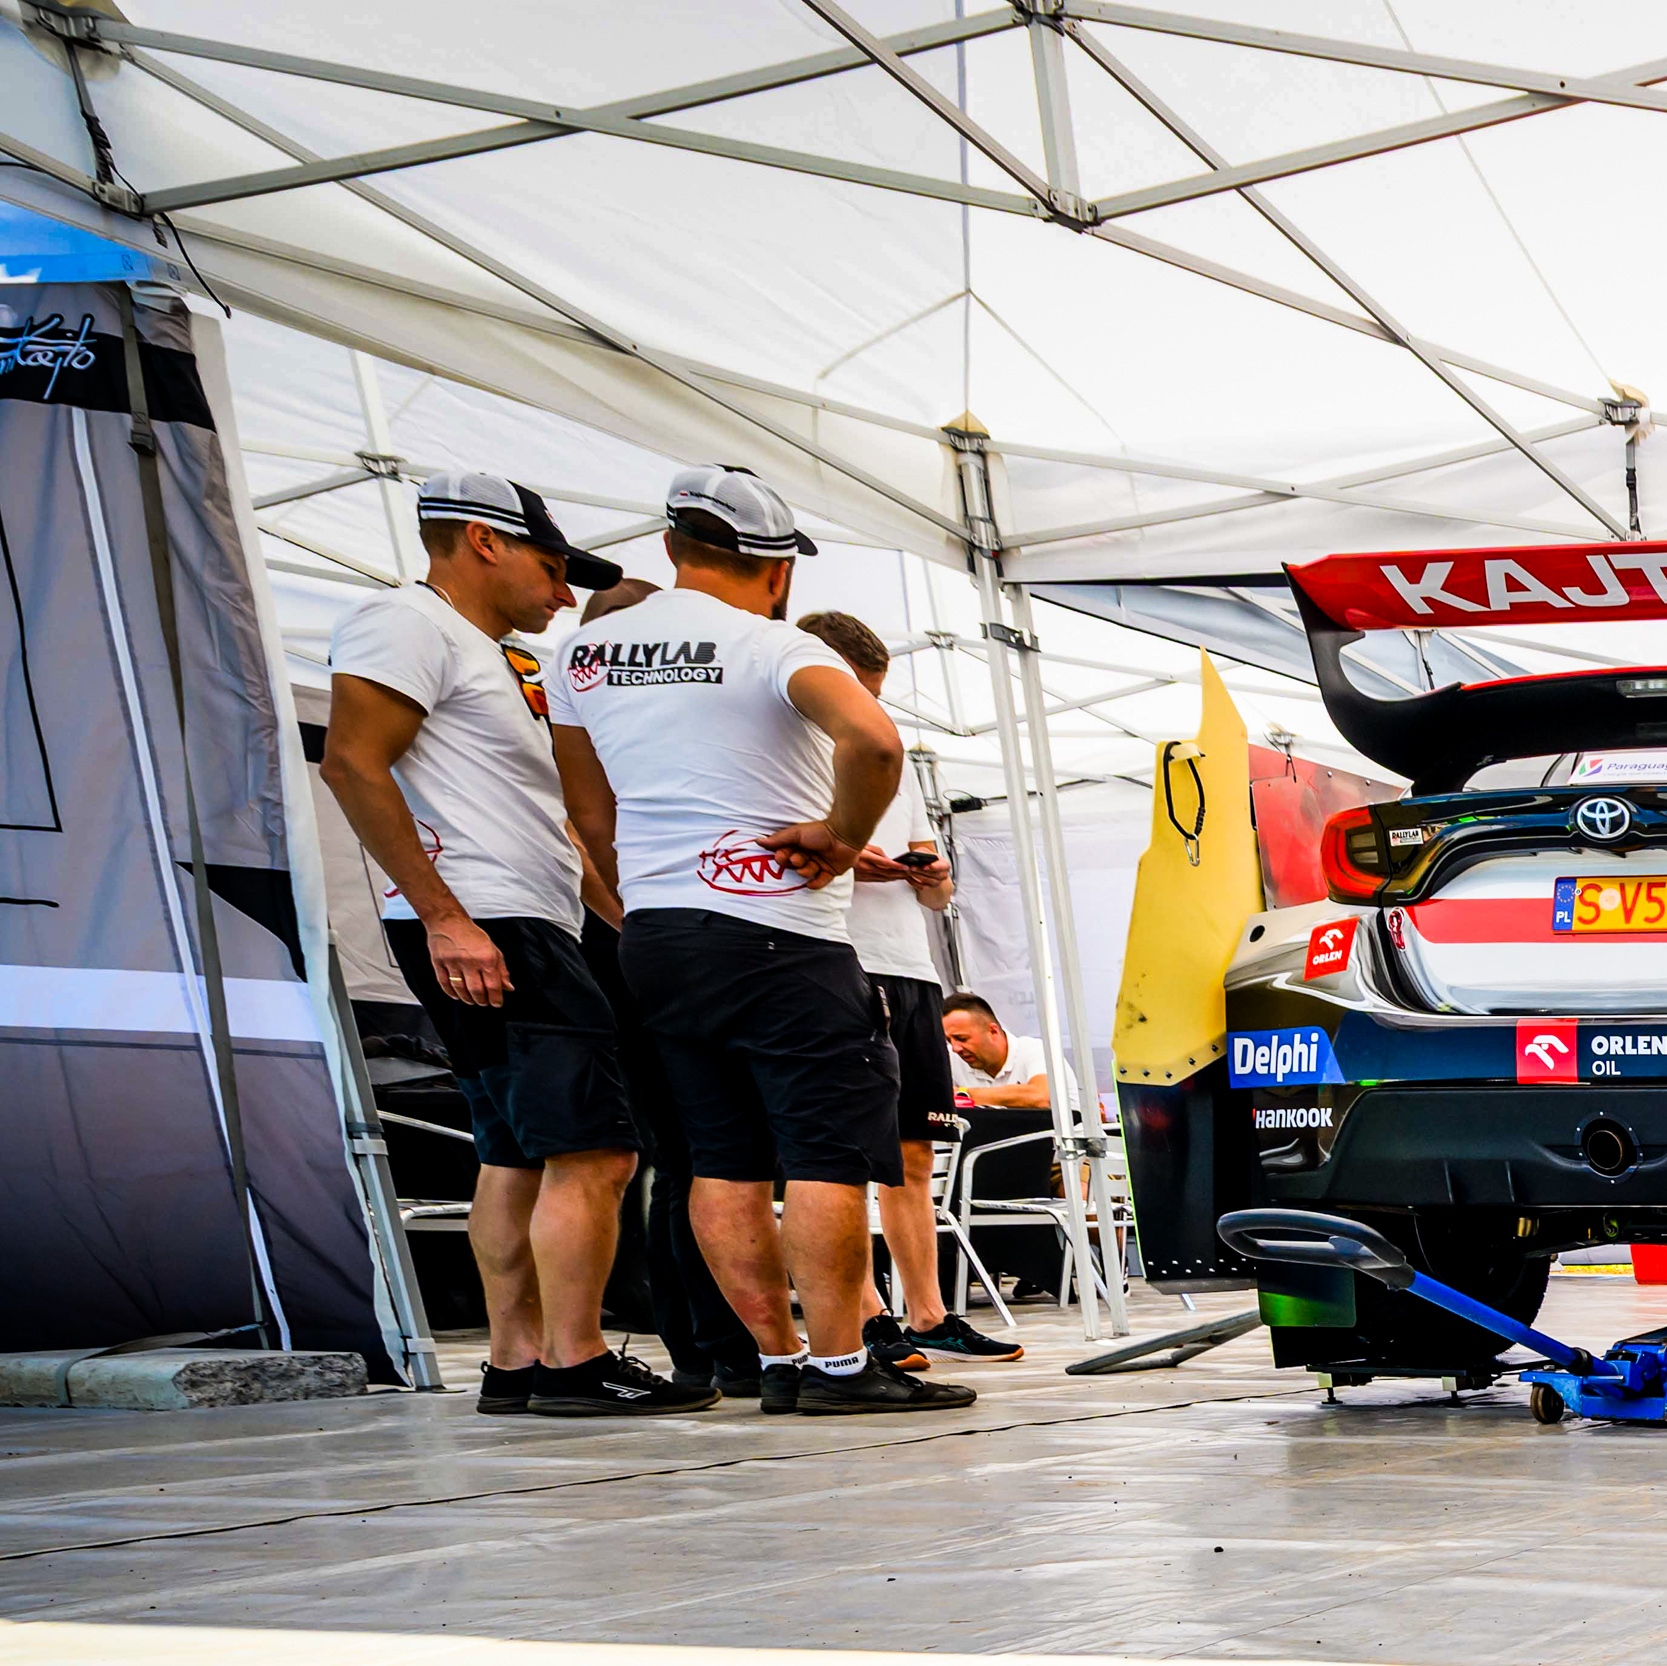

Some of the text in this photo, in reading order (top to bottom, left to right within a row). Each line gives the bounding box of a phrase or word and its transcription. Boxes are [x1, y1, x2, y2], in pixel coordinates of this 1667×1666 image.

[570, 641, 717, 669] RALLYLAB
[610, 668, 721, 685] TECHNOLOGY
[1392, 830, 1420, 839] RALLYLAB
[1555, 911, 1571, 923] PL
[1312, 950, 1342, 965] ORLEN
[1233, 1032, 1319, 1083] Delphi
[1592, 1060, 1621, 1076] OIL
[791, 1352, 810, 1365] PUM
[825, 1356, 859, 1369] PUMA
